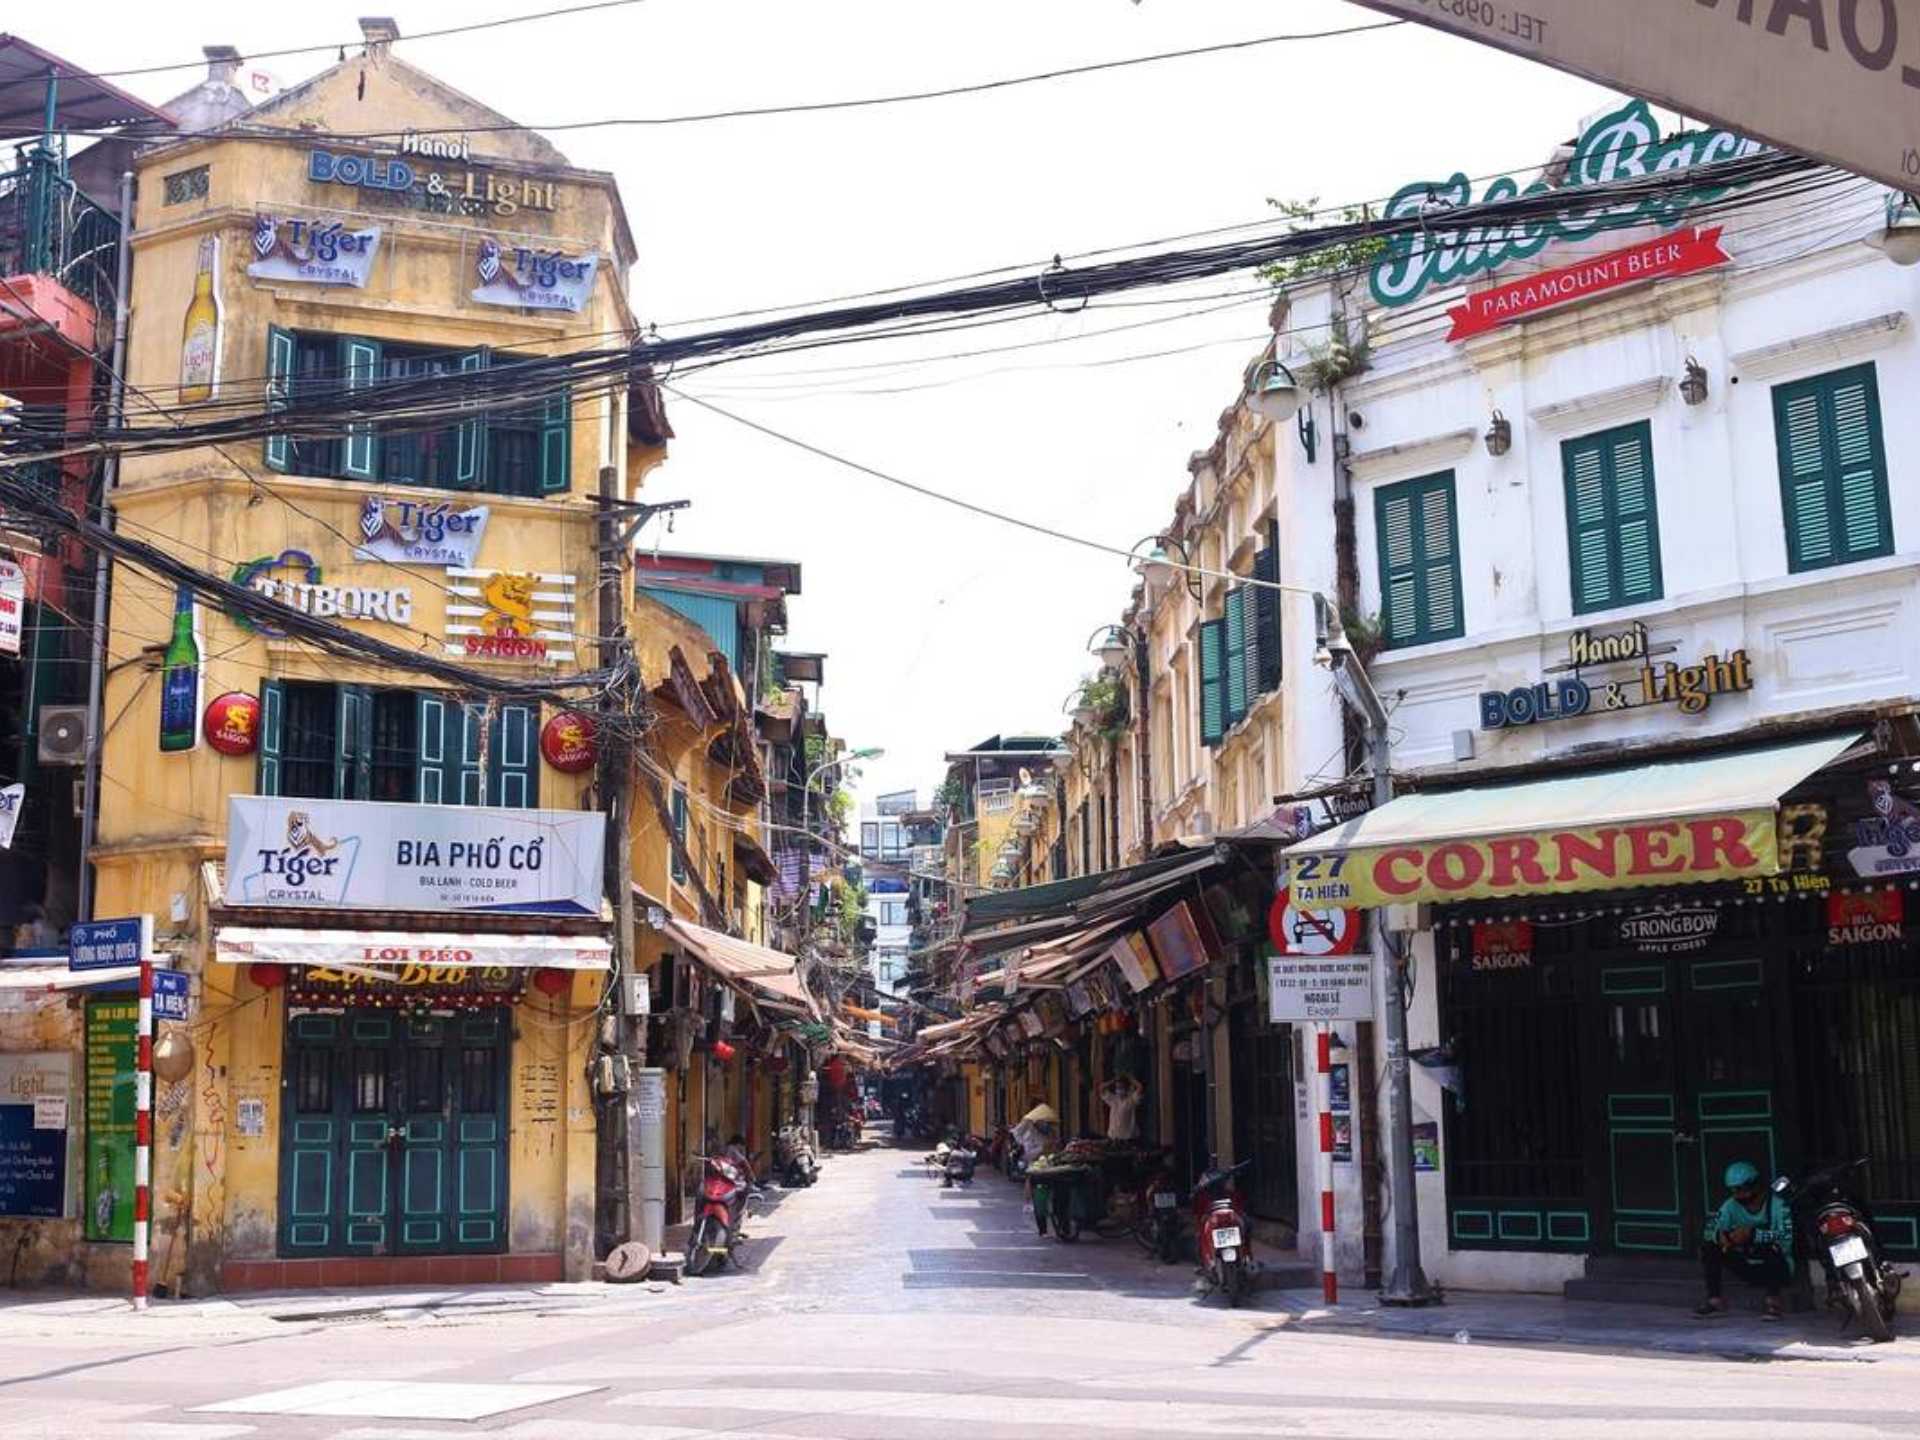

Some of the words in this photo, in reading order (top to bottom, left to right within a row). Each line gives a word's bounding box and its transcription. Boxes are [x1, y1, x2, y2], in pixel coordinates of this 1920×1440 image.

[402, 132, 471, 160] Hanoi
[308, 151, 415, 191] BOLD
[426, 172, 448, 195] &
[465, 171, 557, 217] Light
[286, 219, 374, 262] Tiger
[299, 265, 360, 281] CRYSTAL
[511, 247, 592, 288] Tiger
[1482, 265, 1620, 316] PARAMOUNT
[1627, 244, 1681, 274] BEER
[519, 292, 576, 307] CRYSTAL
[398, 501, 481, 543] Tiger
[403, 547, 466, 564] CRYSTAL
[255, 577, 412, 626] TUBORG
[464, 633, 547, 658] SAIGON
[1570, 621, 1648, 666] Hanoi
[1479, 678, 1591, 731] BOLD
[1604, 681, 1626, 711] &
[1640, 649, 1754, 715] Light
[215, 730, 250, 744] SAIGON
[396, 840, 440, 867] BIA
[449, 836, 505, 870] PHỐ
[509, 836, 545, 871] CỔ
[1296, 852, 1349, 881] 27
[1371, 817, 1759, 896] CORNER
[258, 847, 339, 887] Tiger
[268, 889, 326, 901] CRYSTAL
[419, 875, 436, 888] BIA
[469, 877, 493, 889] COLD
[495, 878, 518, 889] BEER
[1743, 877, 1764, 894] 27
[1620, 914, 1719, 938] STRONGBOW
[1828, 922, 1901, 945] SAIGON
[1472, 951, 1531, 971] SAIGON
[1637, 943, 1668, 953] APPLE
[1307, 1005, 1339, 1016] Except
